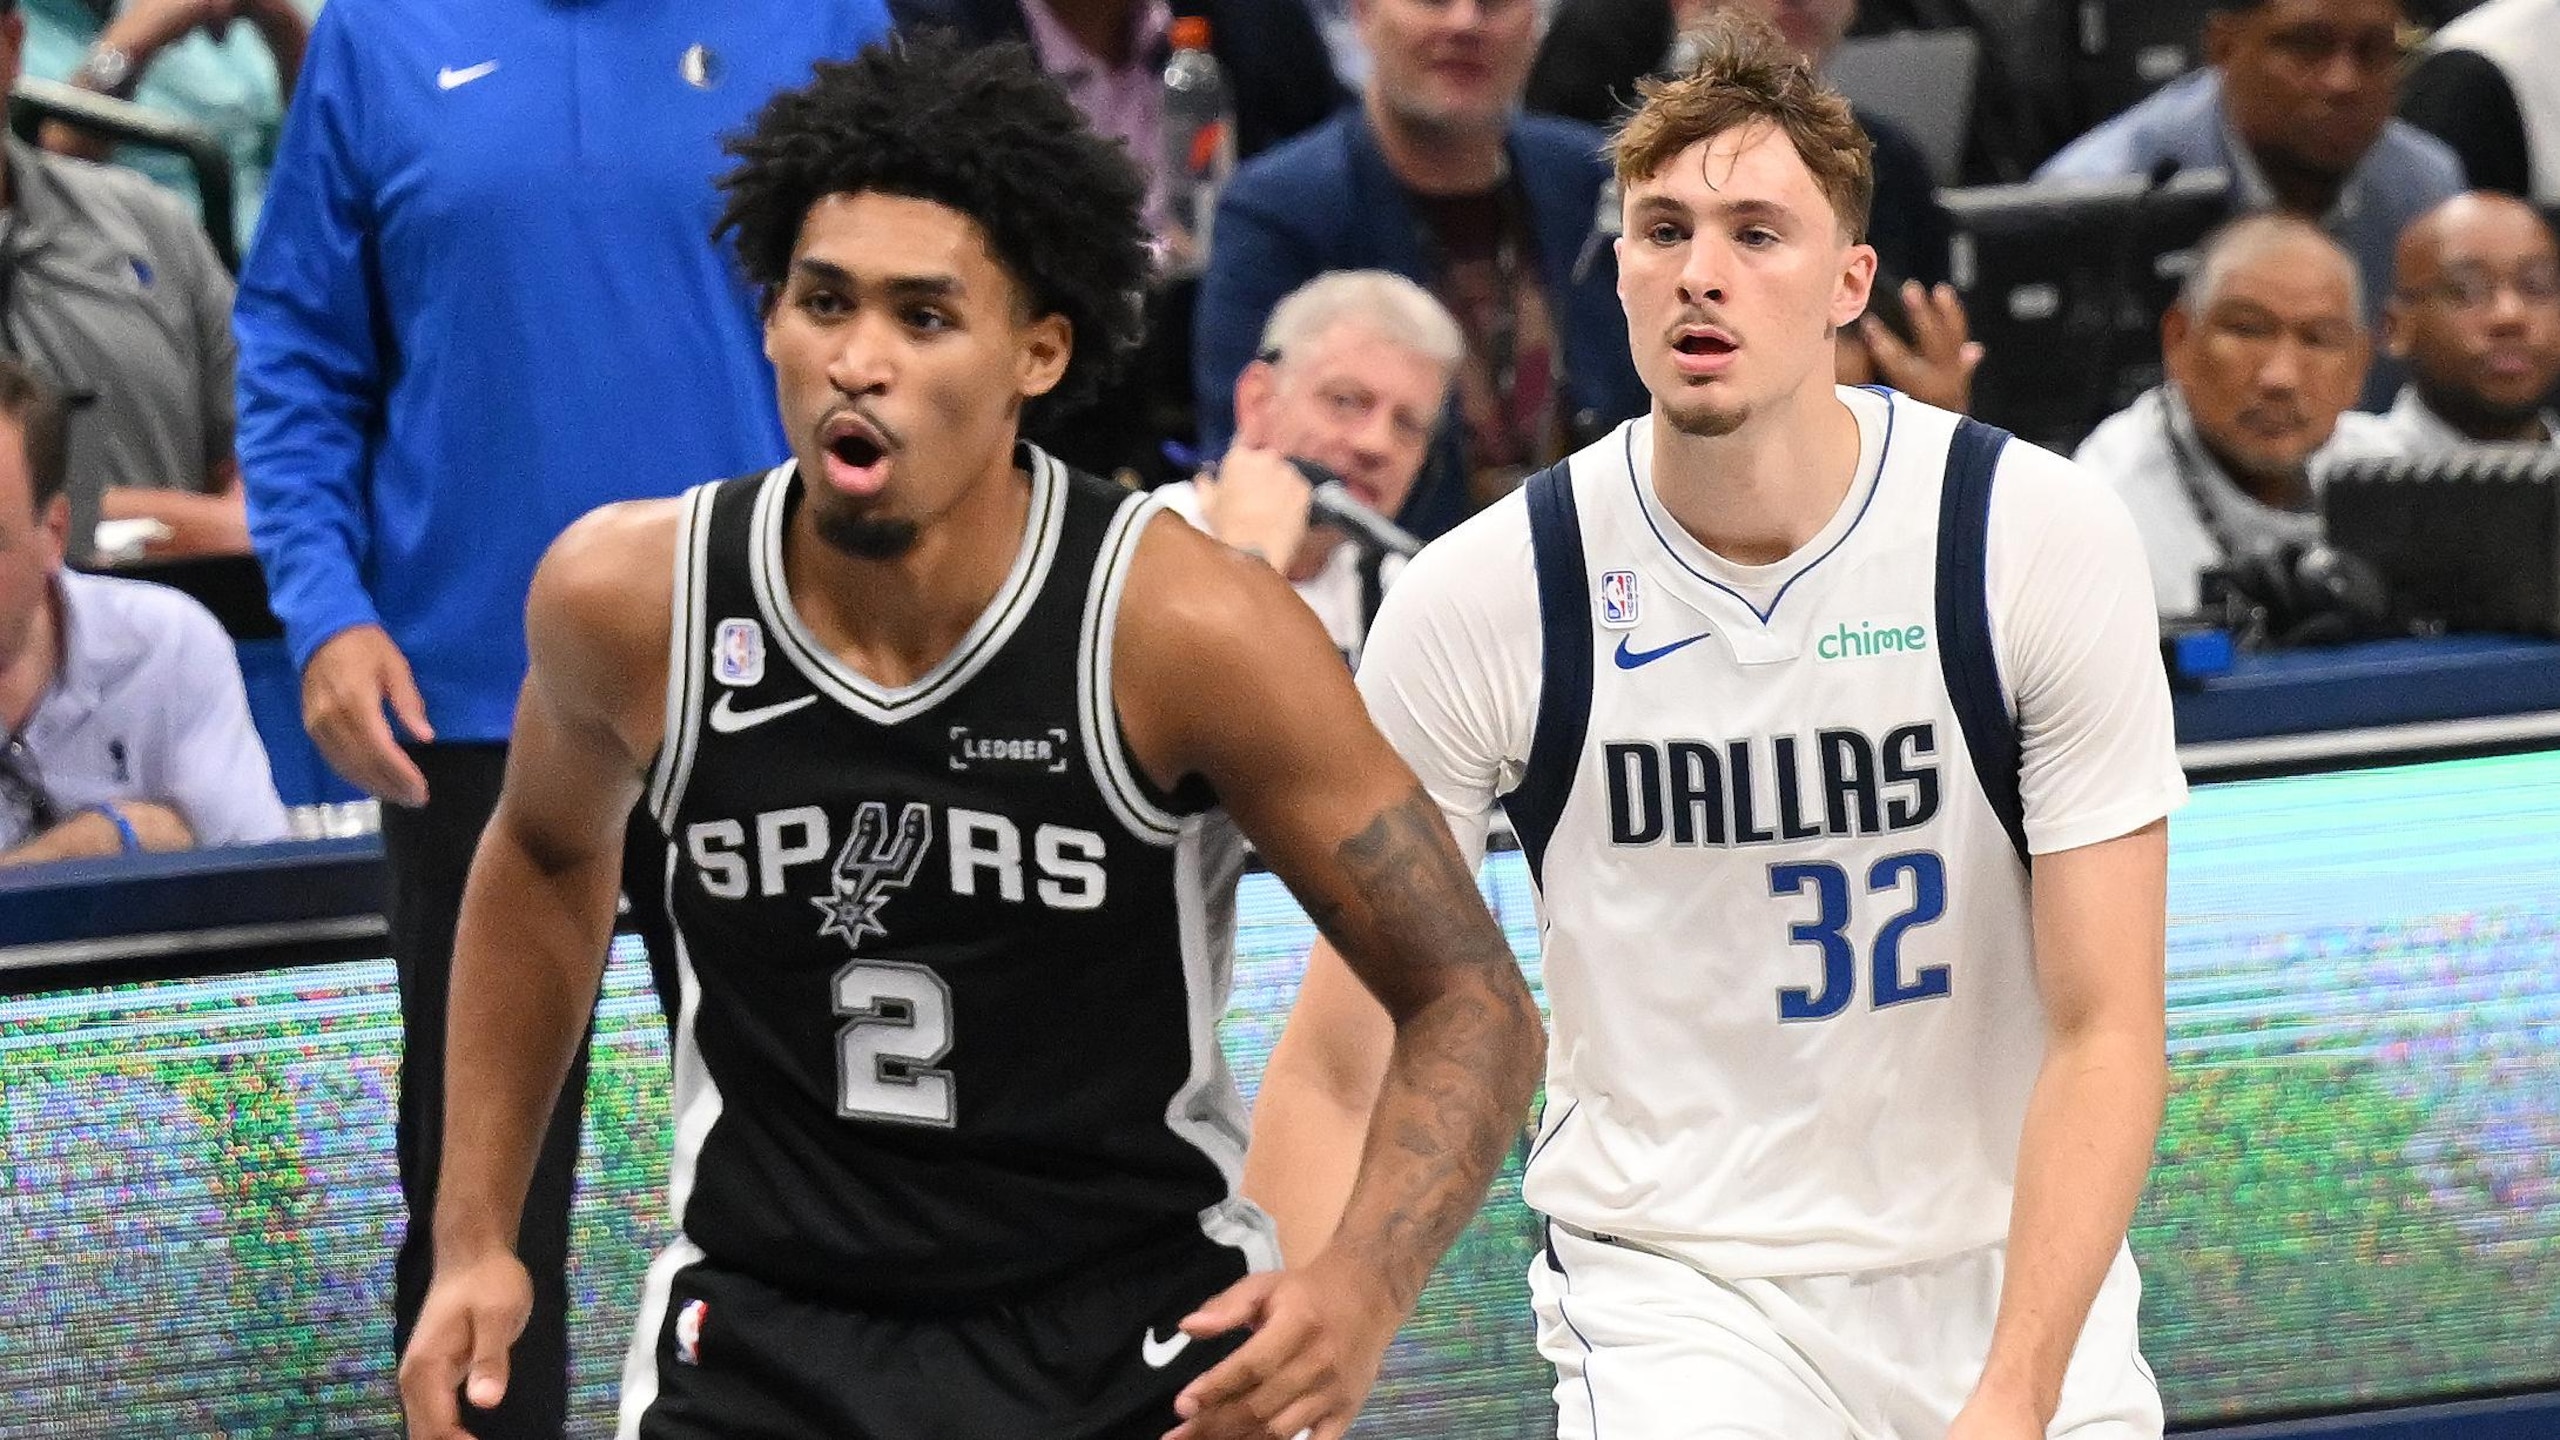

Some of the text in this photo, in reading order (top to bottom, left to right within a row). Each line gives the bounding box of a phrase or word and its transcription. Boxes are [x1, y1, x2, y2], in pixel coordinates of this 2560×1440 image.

[1818, 621, 1926, 659] chime
[963, 738, 1052, 760] LEDGER
[1600, 718, 1945, 849] DALLAS
[686, 801, 1107, 947] SPURS
[1766, 849, 1952, 1024] 32
[830, 958, 957, 1129] 2
